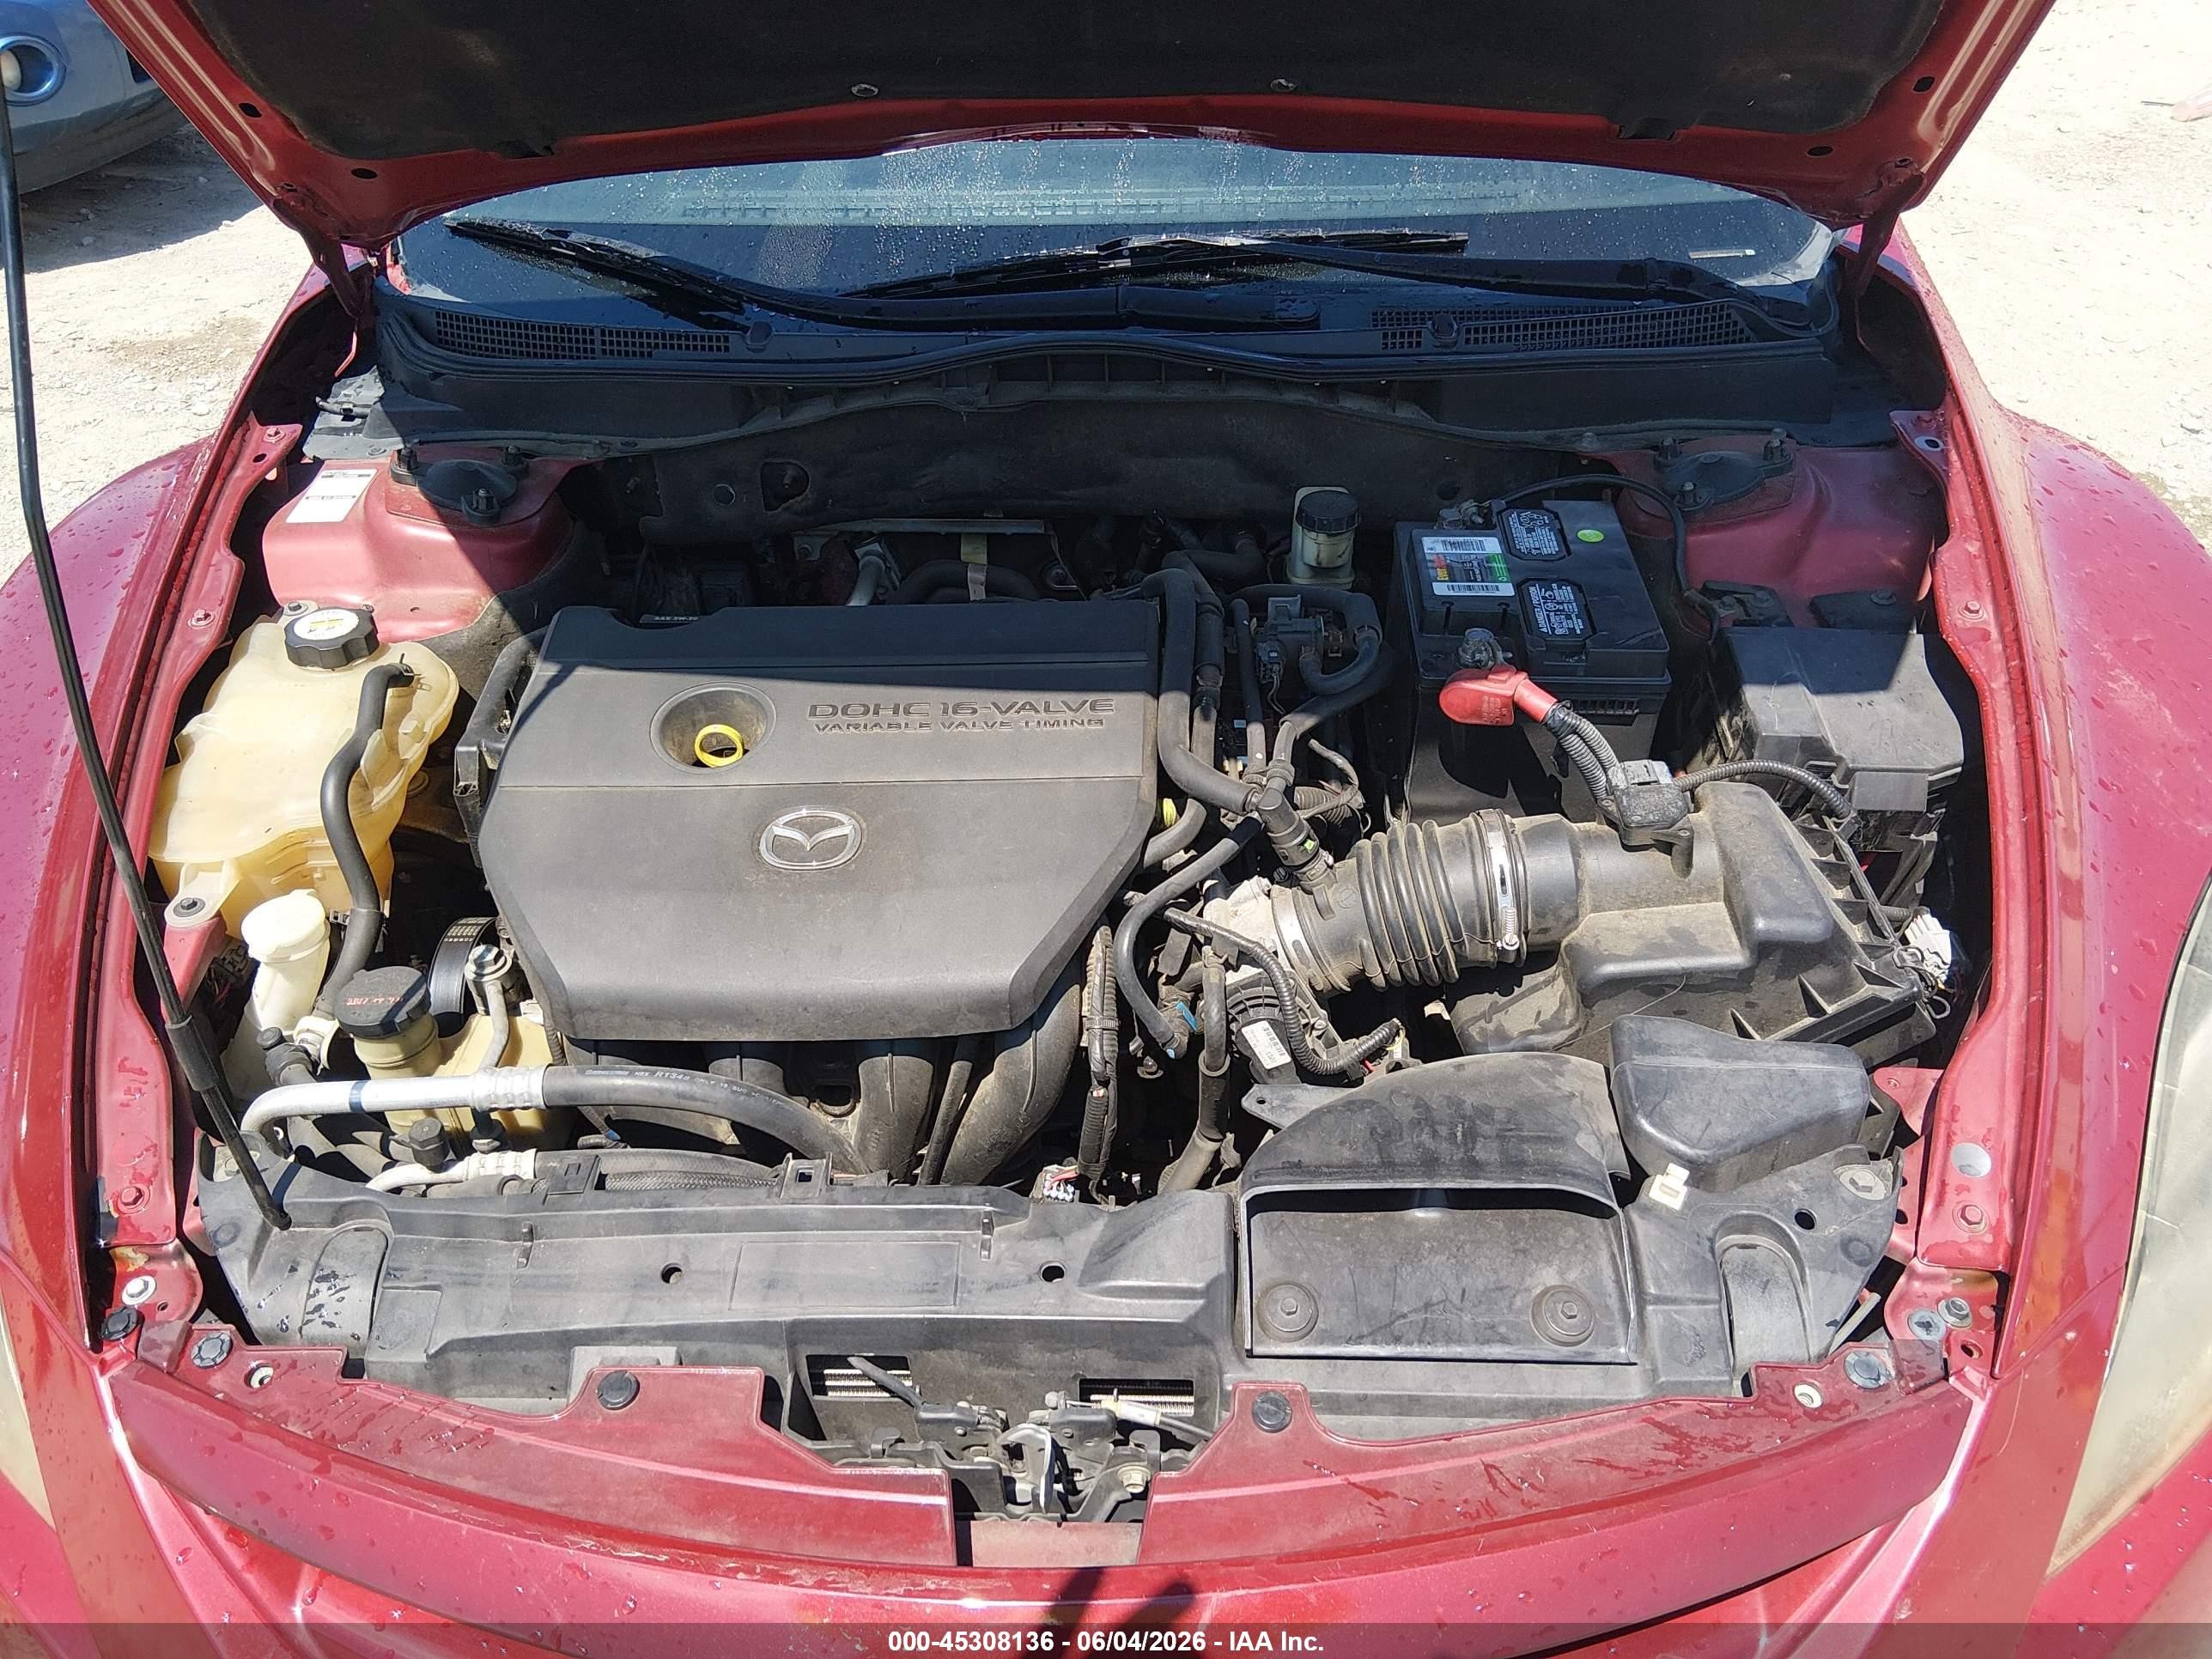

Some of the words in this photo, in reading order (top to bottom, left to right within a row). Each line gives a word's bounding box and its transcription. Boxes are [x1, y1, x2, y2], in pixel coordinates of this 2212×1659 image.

[808, 702, 932, 720] DOHC
[940, 698, 1115, 716] 16-VALVE
[814, 720, 933, 732] VARIABLE
[939, 720, 1013, 730] VALVE
[1019, 718, 1104, 728] TIMING
